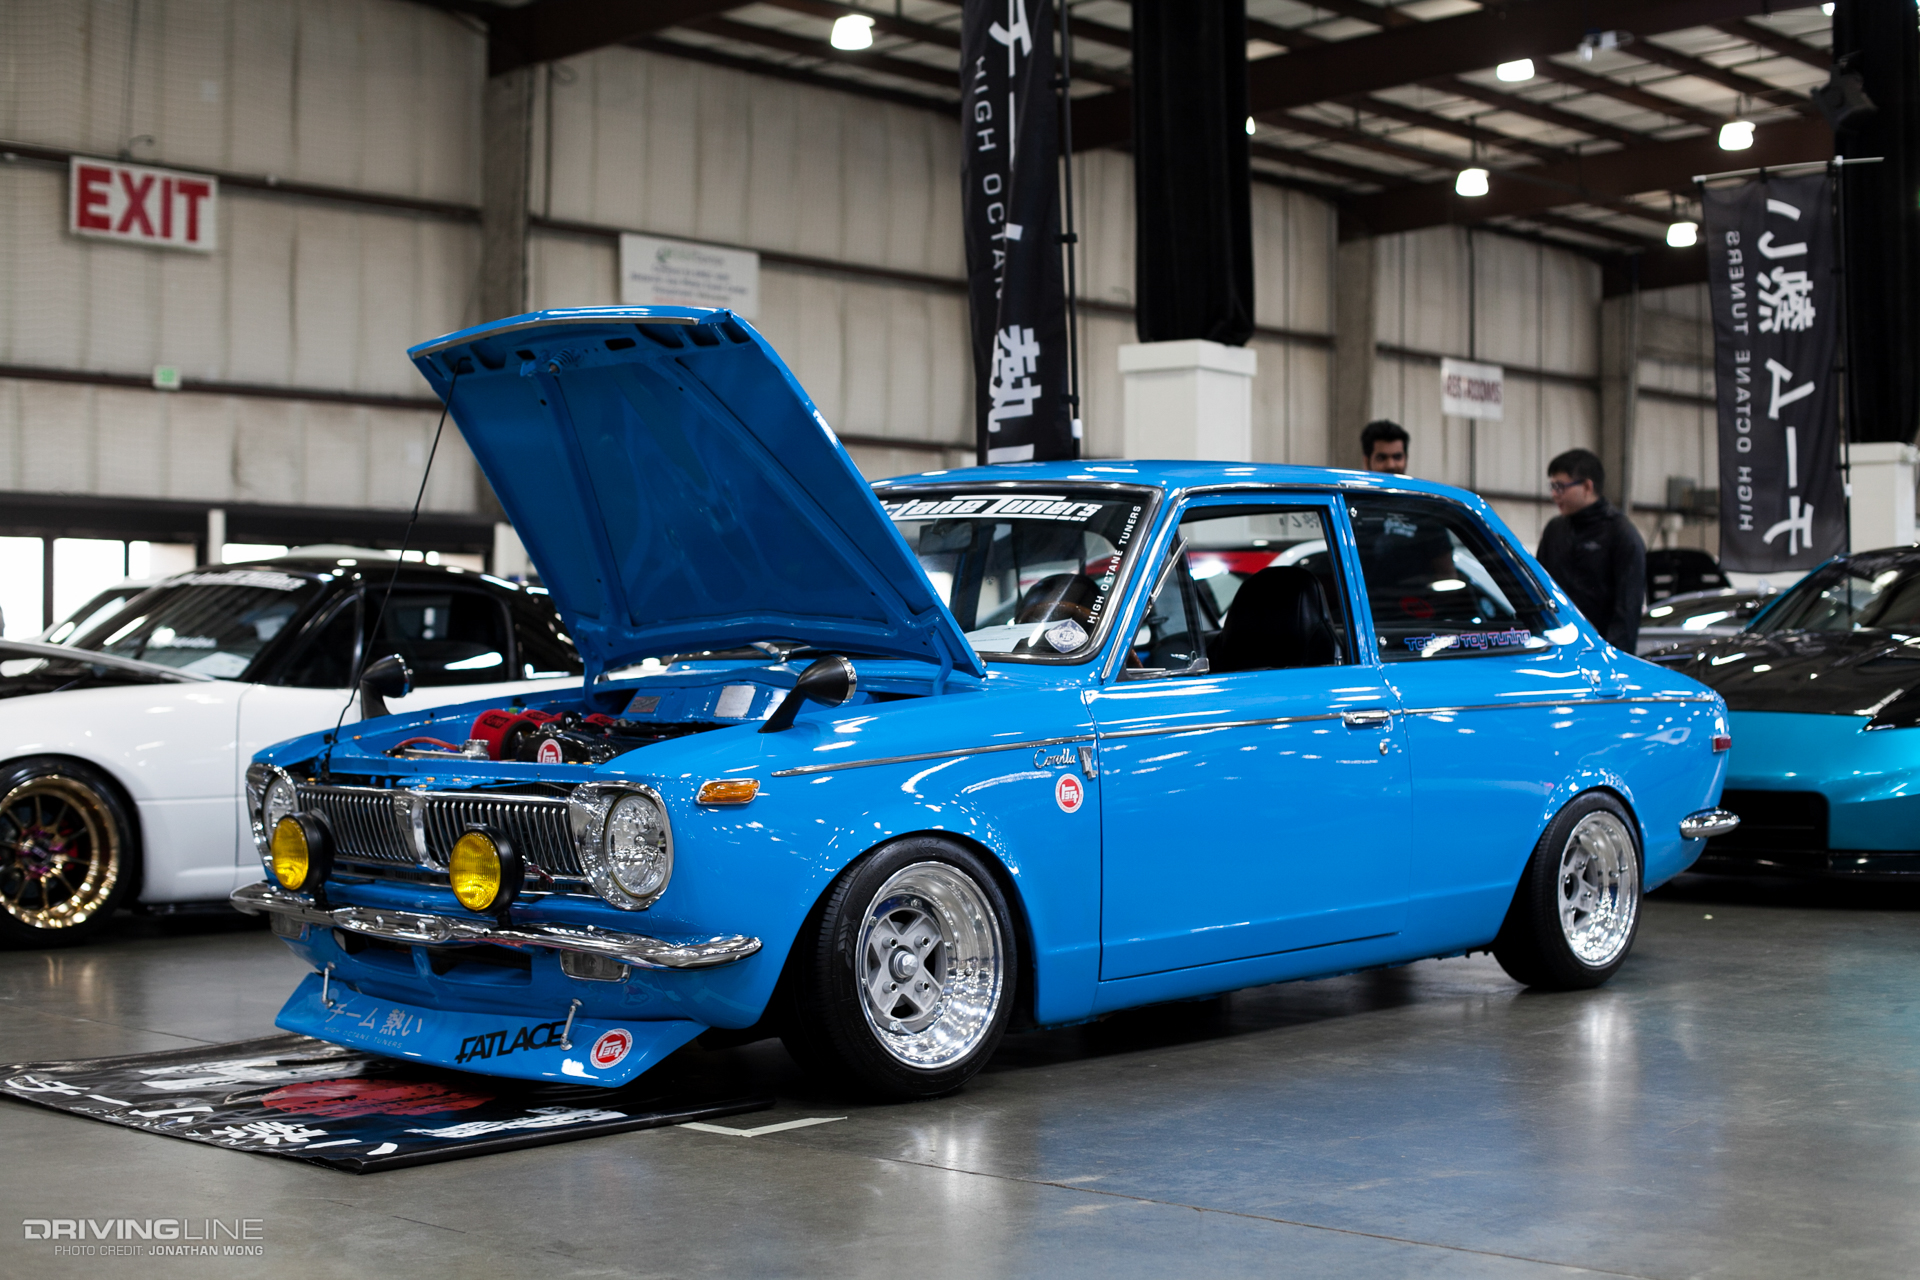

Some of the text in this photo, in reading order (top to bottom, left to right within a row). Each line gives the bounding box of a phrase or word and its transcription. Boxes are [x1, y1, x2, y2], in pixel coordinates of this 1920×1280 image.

[77, 165, 210, 242] EXIT
[880, 494, 1103, 521] ctane Tuners
[1087, 505, 1141, 624] HIGH OCTANE TUNERS
[1034, 748, 1076, 769] Corolla
[343, 1029, 371, 1041] OCTANE
[373, 1036, 403, 1049] TUNERS
[454, 1020, 567, 1064] FATLACE
